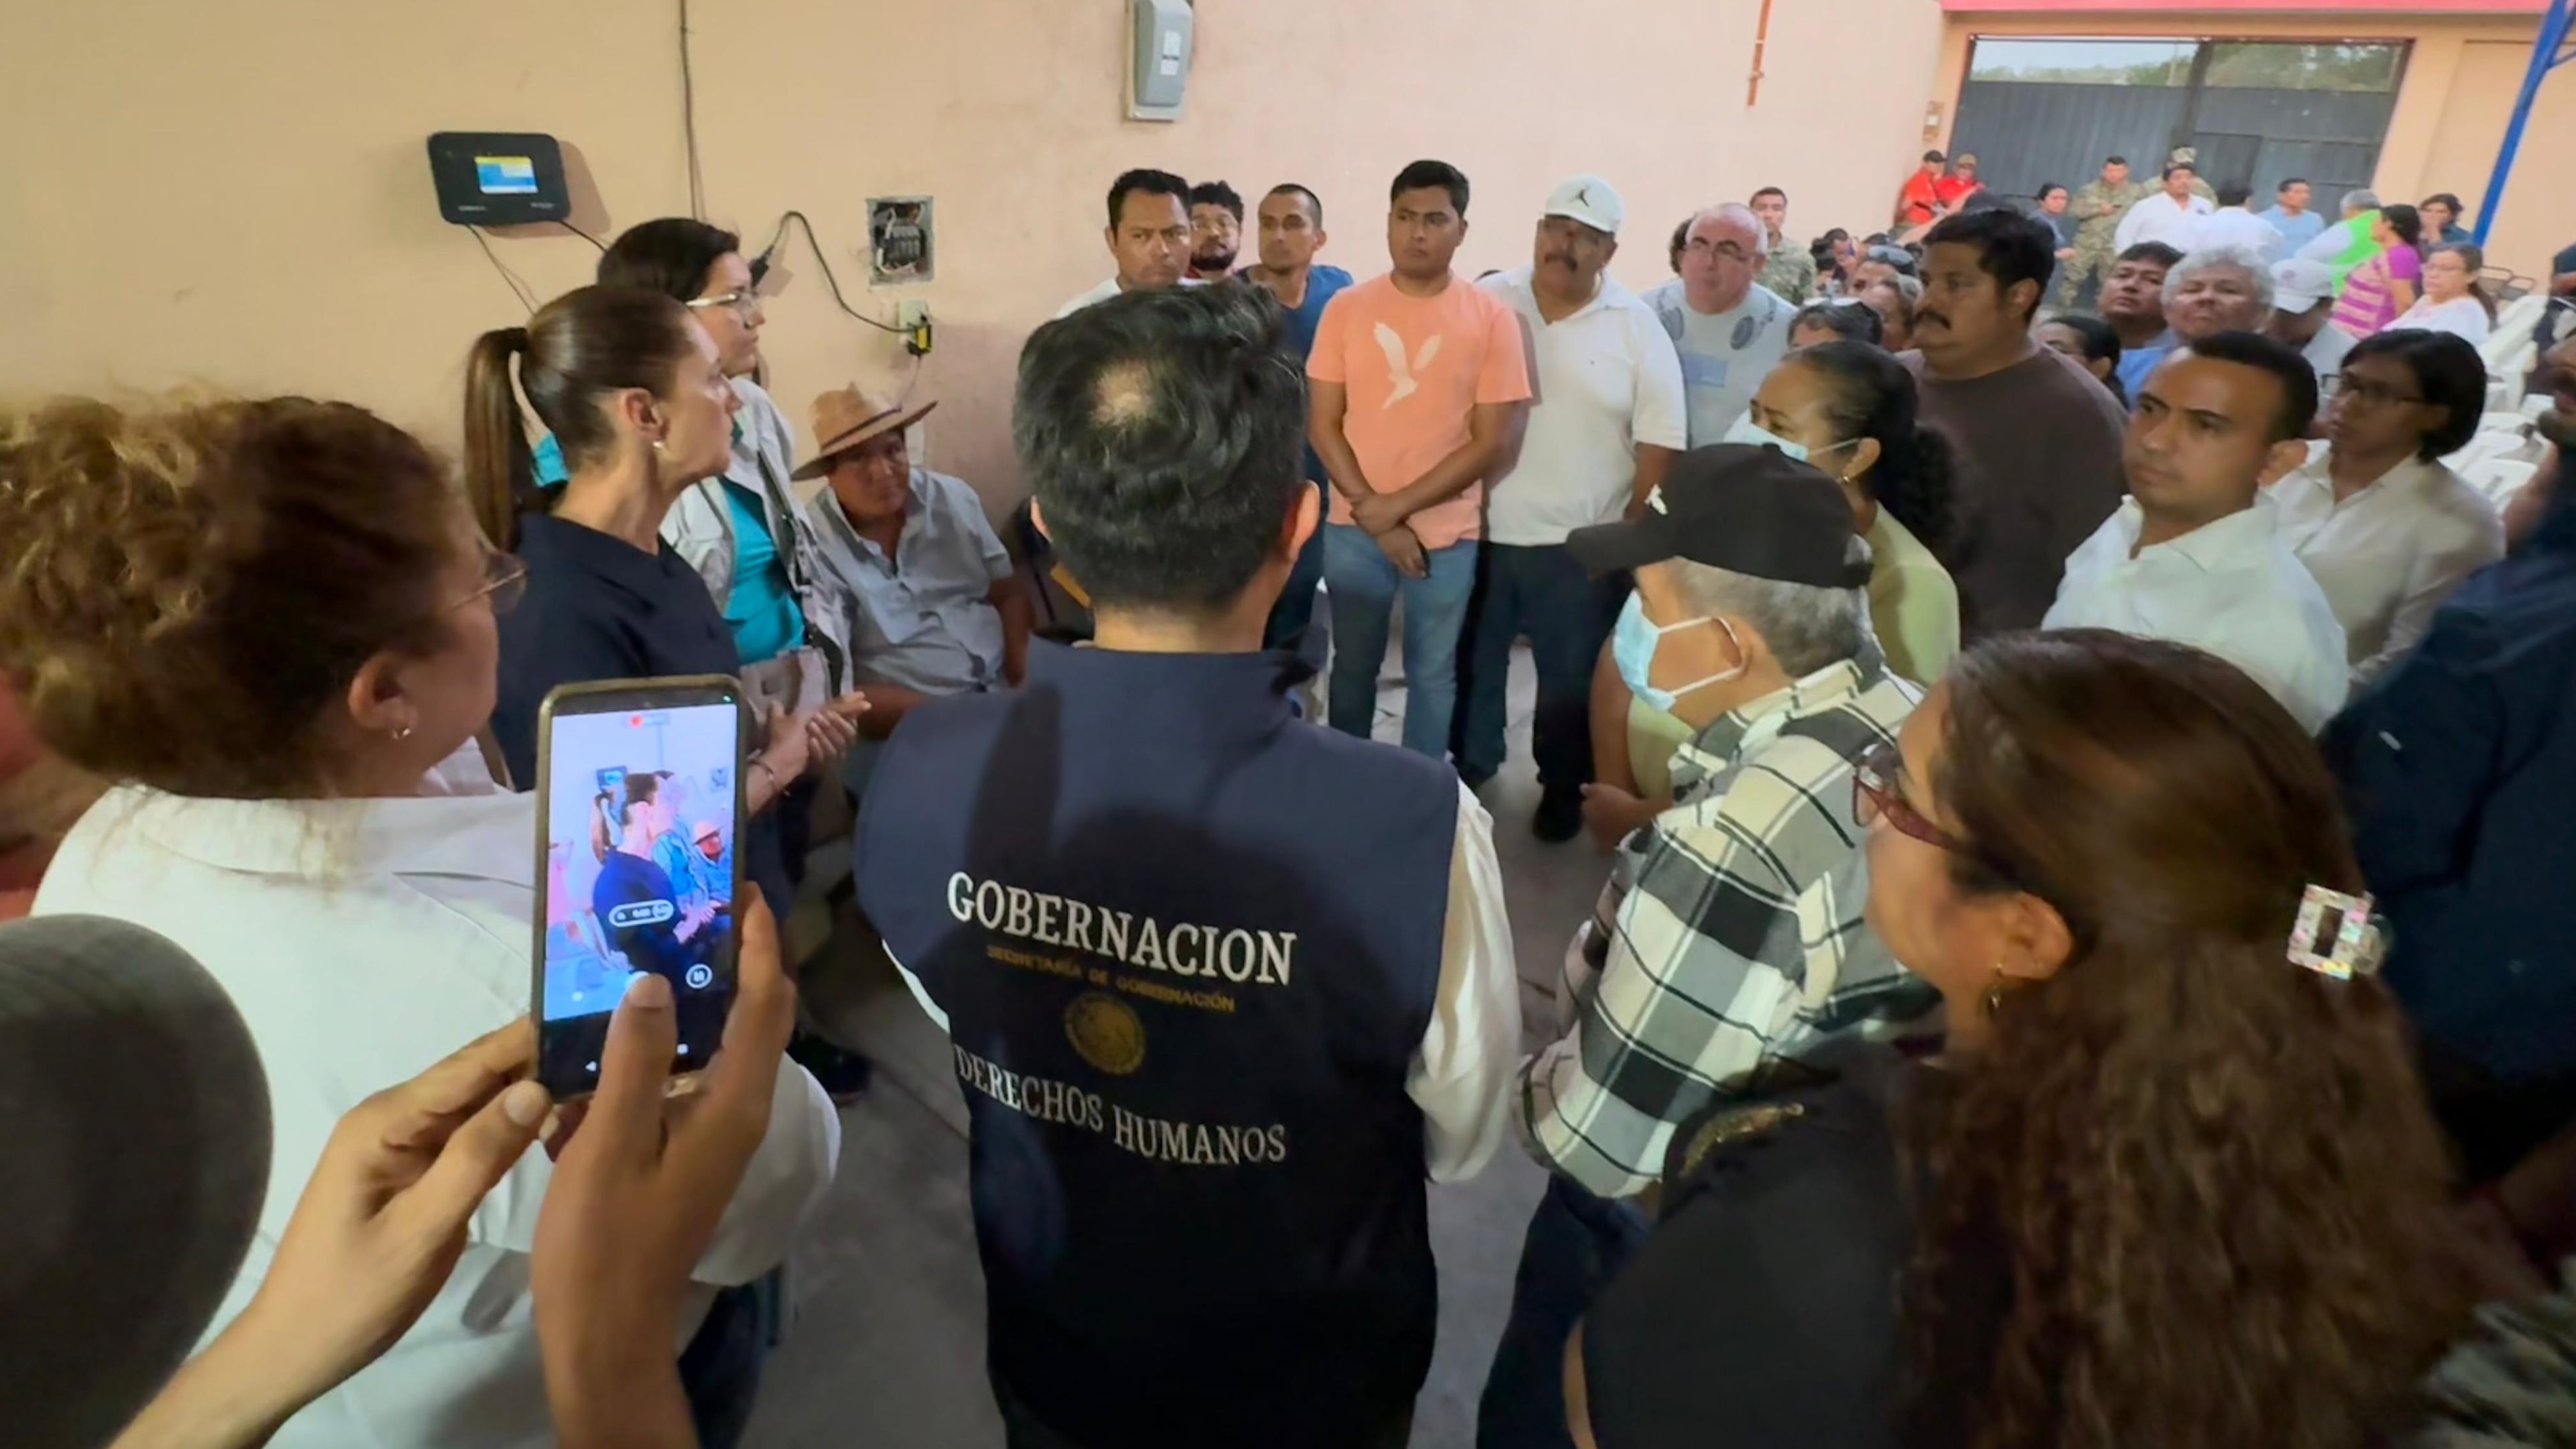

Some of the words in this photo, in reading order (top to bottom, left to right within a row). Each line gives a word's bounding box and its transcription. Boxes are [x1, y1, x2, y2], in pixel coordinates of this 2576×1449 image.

[947, 871, 1297, 985] GOBERNACION
[1089, 969, 1109, 985] DE
[1116, 975, 1236, 1013] GOBERNACIÓN
[955, 1043, 1103, 1131] DERECHOS
[1112, 1104, 1286, 1165] HUMANOS
